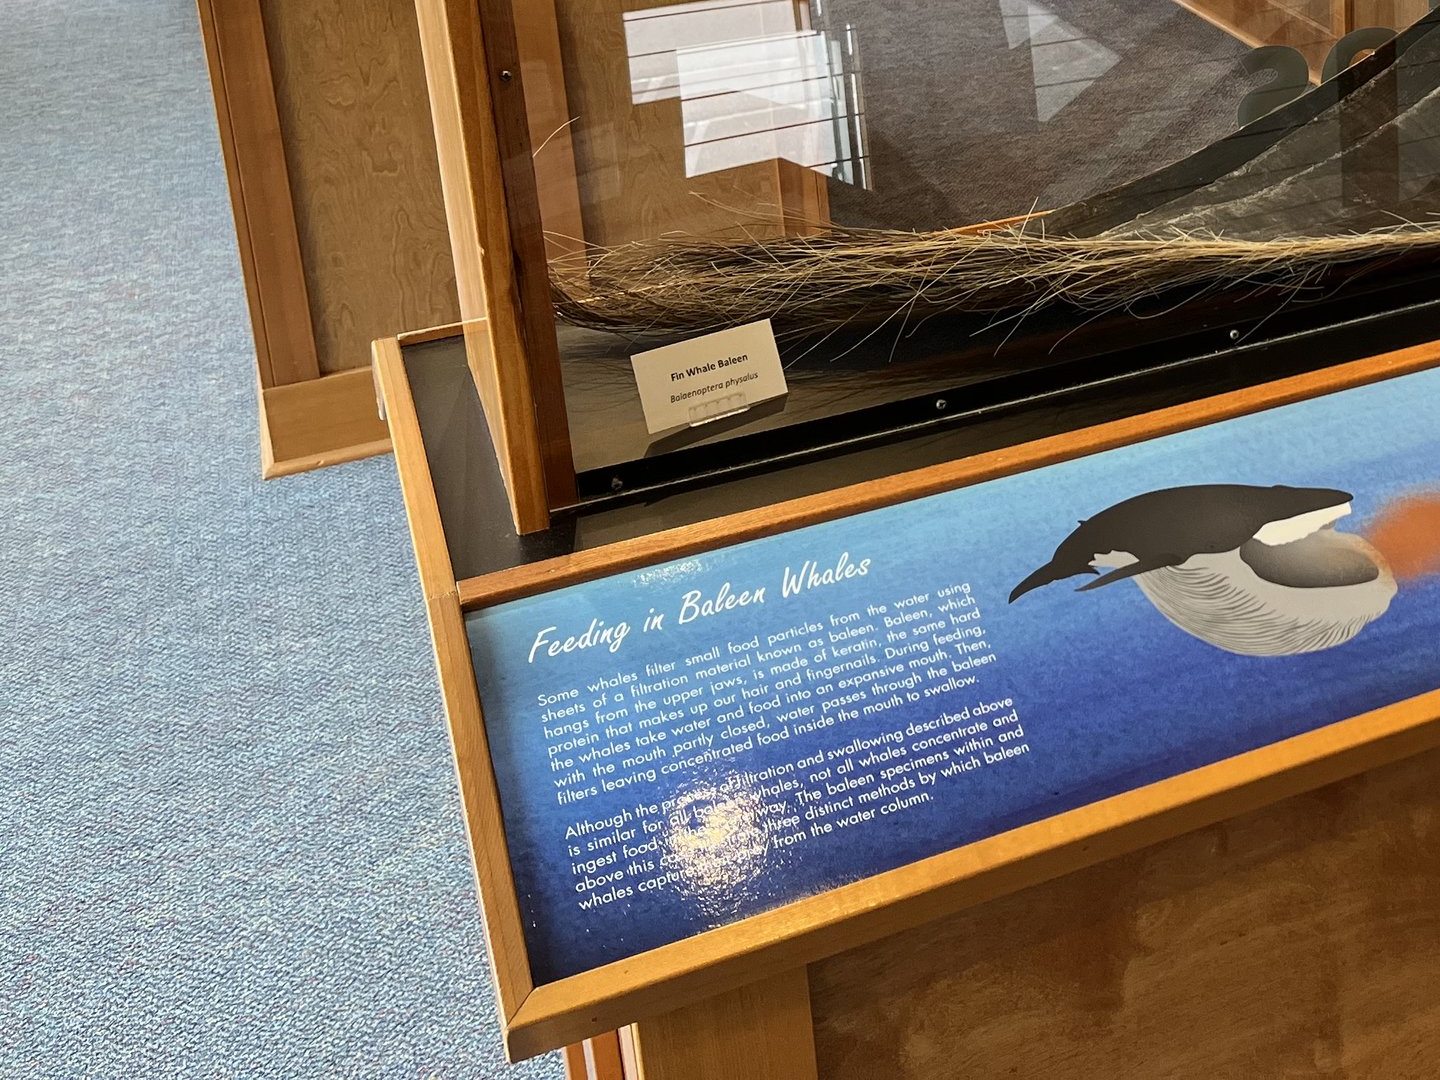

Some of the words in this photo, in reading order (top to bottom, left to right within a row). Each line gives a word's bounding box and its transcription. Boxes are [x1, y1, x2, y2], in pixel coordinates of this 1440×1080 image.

[670, 372, 685, 382] Fin
[686, 363, 716, 377] Whale
[717, 354, 748, 369] Baleen
[670, 382, 723, 403] Balaenoptera
[725, 372, 759, 389] physalus
[528, 618, 631, 663] Feeding
[643, 608, 665, 632] in
[678, 582, 766, 625] Baleen
[781, 551, 871, 598] Whales
[538, 689, 579, 706] Some
[587, 673, 638, 692] whales
[646, 662, 676, 677] filter
[685, 647, 720, 666] small
[727, 637, 760, 654] food
[767, 622, 824, 647] particles
[830, 612, 860, 627] from
[867, 605, 887, 616] the
[894, 593, 929, 609] water
[937, 583, 971, 598] using
[541, 704, 586, 722] sheets
[592, 693, 608, 708] of
[614, 693, 624, 702] a
[630, 675, 689, 697] filtration
[695, 655, 751, 680] material
[756, 644, 802, 663] known
[808, 638, 824, 648] as
[828, 624, 878, 643] baleen.
[883, 610, 933, 628] Baleen,
[937, 596, 976, 613] which
[544, 719, 590, 739] hangs
[595, 708, 628, 724] from
[634, 701, 657, 713] the
[663, 687, 703, 706] upper
[710, 676, 747, 695] jaws,
[752, 669, 765, 680] is
[770, 657, 808, 675] made
[814, 650, 827, 663] of
[831, 639, 882, 657] keratin,
[886, 631, 907, 643] the
[912, 621, 946, 636] same
[949, 608, 981, 625] hard
[548, 733, 600, 758] protein
[605, 722, 633, 739] that
[639, 710, 684, 729] makes
[690, 703, 708, 715] up
[713, 694, 736, 707] our
[741, 684, 769, 700] hair
[775, 673, 802, 690] and
[806, 654, 880, 681] fingernails.
[884, 641, 930, 659] During
[933, 626, 986, 645] feeding,
[551, 758, 574, 772] the
[578, 742, 631, 763] whales
[635, 732, 667, 747] take
[671, 718, 711, 736] water
[717, 706, 745, 723] and
[748, 696, 781, 714] food
[785, 690, 811, 703] into
[816, 684, 834, 695] an
[838, 664, 904, 689] expansive
[908, 650, 952, 669] mouth.
[957, 640, 991, 655] Then,
[554, 769, 586, 787] with
[592, 763, 615, 777] the
[622, 746, 666, 768] mouth
[673, 734, 714, 757] partly
[720, 717, 770, 739] closed,
[776, 705, 815, 723] water
[822, 691, 867, 714] passes
[871, 674, 922, 695] through
[927, 668, 948, 680] the
[951, 654, 997, 672] baleen
[557, 786, 598, 805] filters
[601, 769, 656, 792] leaving
[661, 737, 753, 774] concentrated
[757, 727, 790, 746] food
[793, 716, 835, 735] inside
[838, 710, 859, 722] the
[863, 695, 903, 715] mouth
[906, 692, 920, 702] to
[924, 675, 979, 697] swallow.
[565, 809, 633, 840] Although
[635, 804, 658, 818] the
[797, 751, 824, 769] and
[827, 731, 904, 760] swallowing
[906, 708, 970, 736] described
[972, 698, 1013, 716] above
[568, 845, 581, 857] is
[587, 829, 636, 851] similar
[642, 820, 662, 834] for
[810, 767, 832, 783] not
[837, 759, 854, 774] all
[858, 747, 907, 767] whales
[912, 722, 988, 752] concentrate
[993, 710, 1018, 727] and
[571, 851, 617, 875] ingest
[623, 837, 657, 858] food
[795, 790, 822, 804] The
[826, 774, 875, 795] baleen
[880, 751, 950, 780] specimens
[953, 737, 994, 756] within
[998, 725, 1024, 743] and
[575, 871, 624, 892] above
[629, 860, 654, 876] this
[805, 796, 853, 820] distinct
[858, 778, 916, 804] methods
[918, 772, 936, 785] by
[940, 757, 981, 777] which
[983, 744, 1030, 764] baleen
[578, 886, 633, 910] whales
[771, 831, 806, 849] from
[810, 823, 833, 837] the
[836, 809, 875, 828] water
[880, 792, 934, 815] column.
